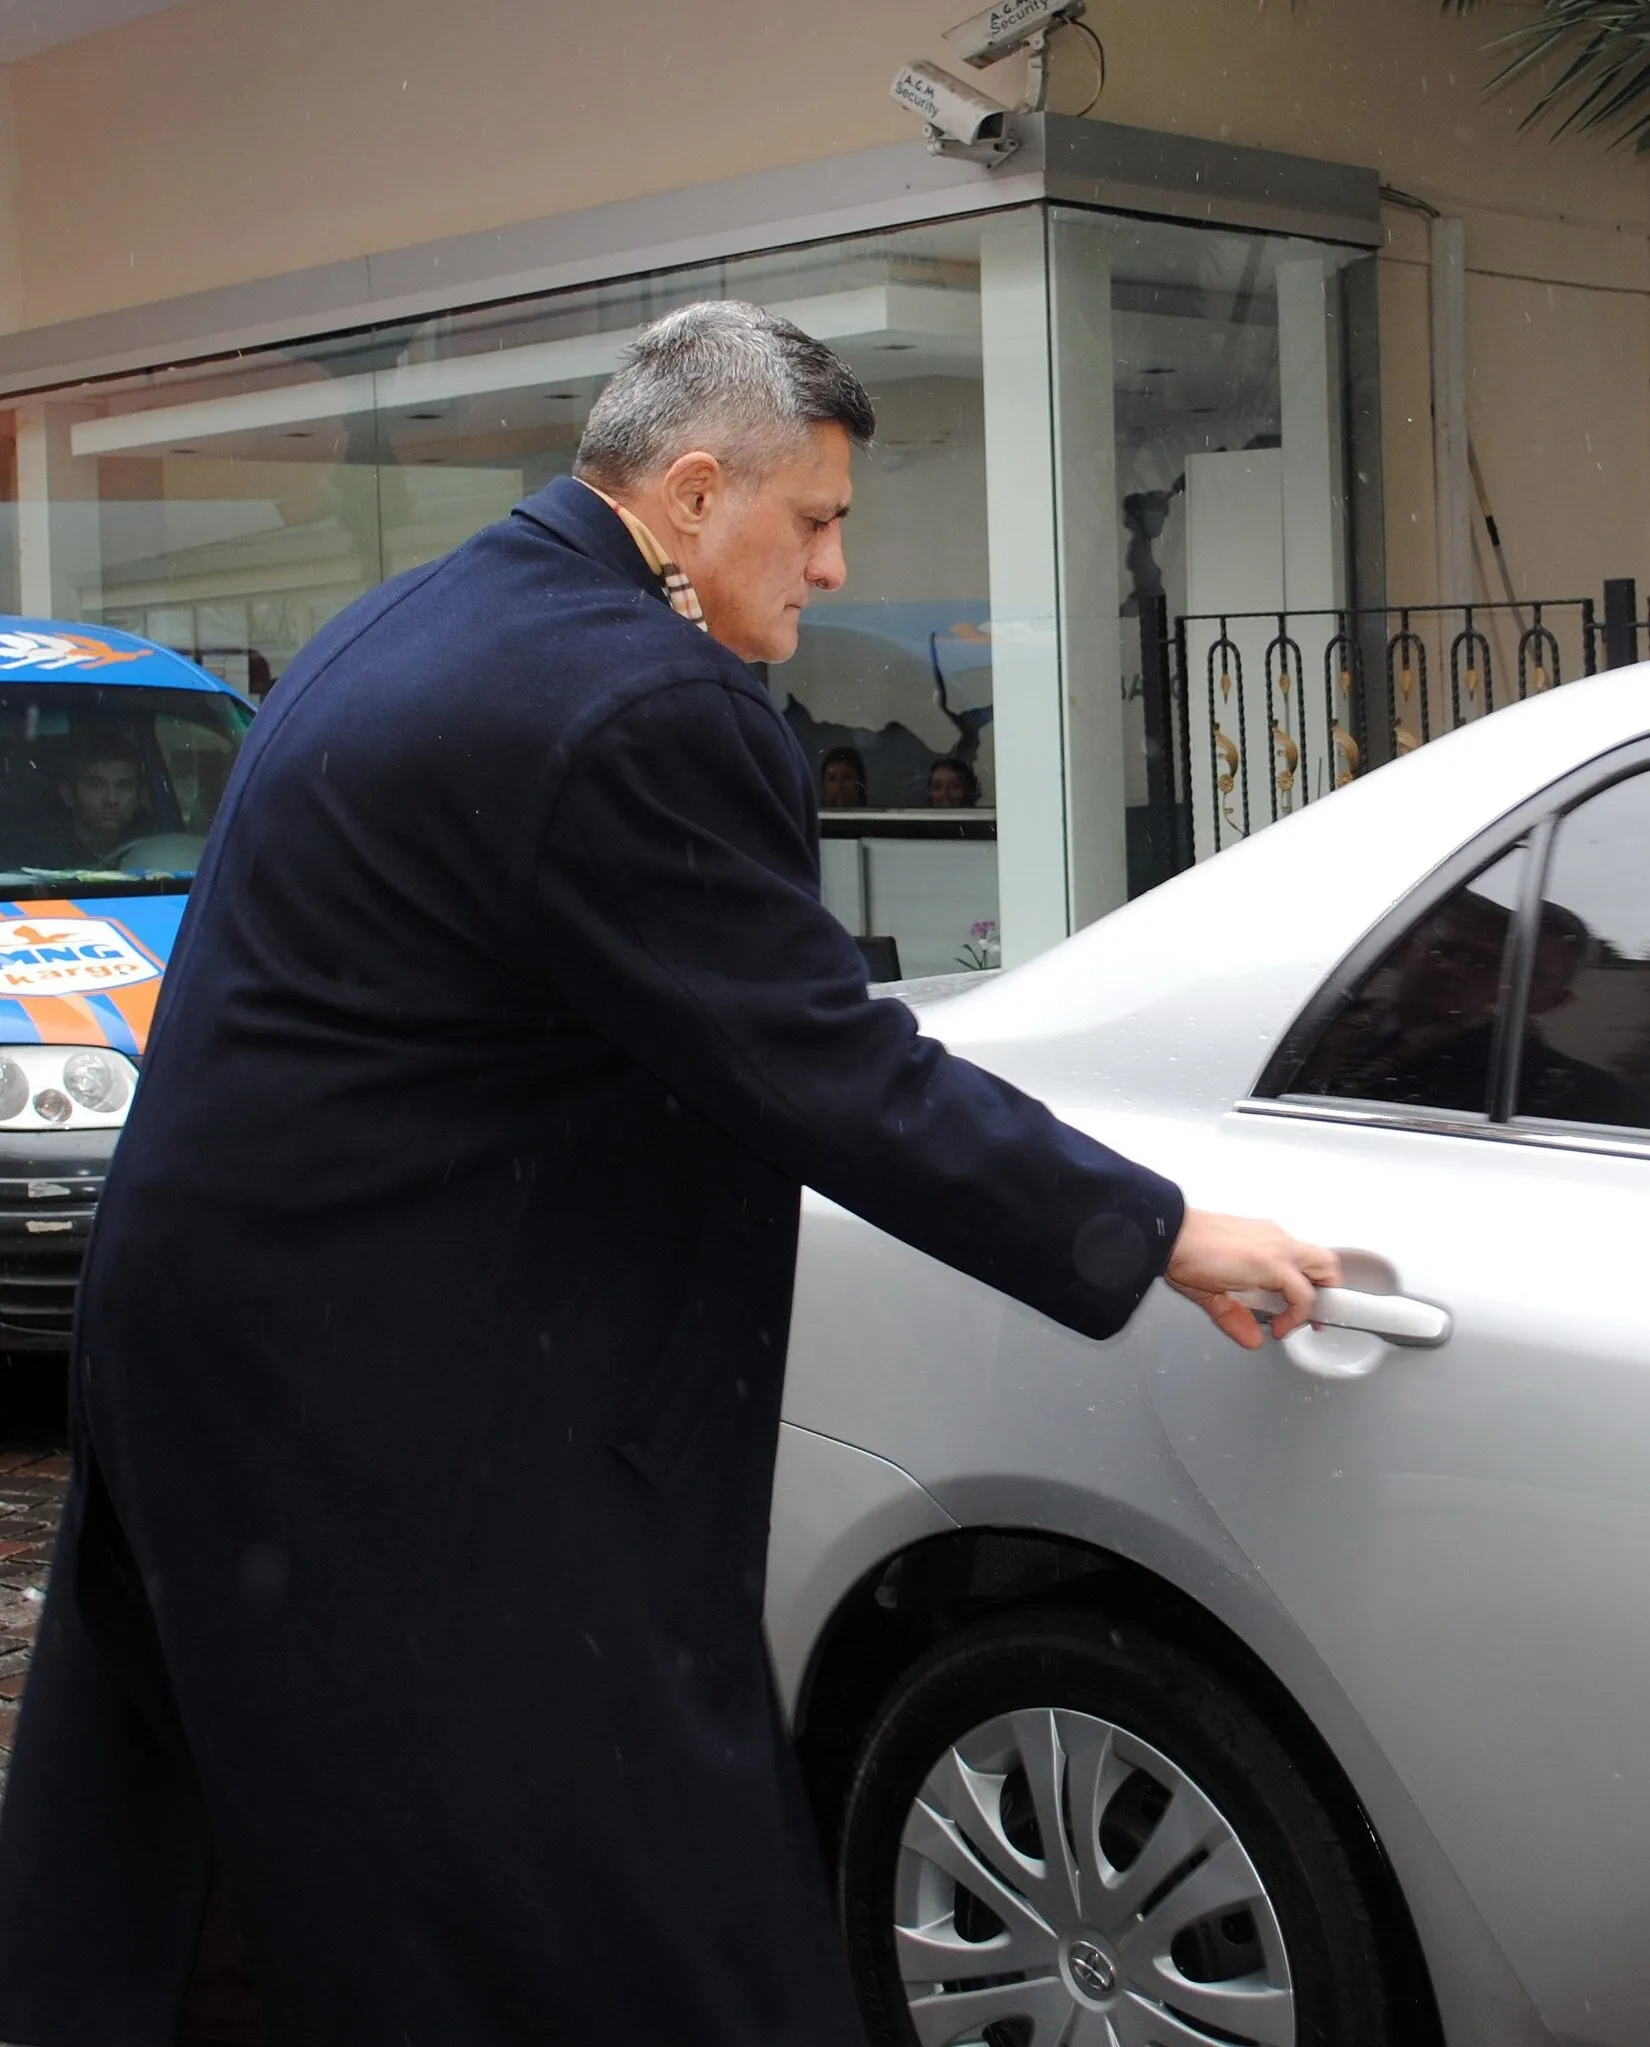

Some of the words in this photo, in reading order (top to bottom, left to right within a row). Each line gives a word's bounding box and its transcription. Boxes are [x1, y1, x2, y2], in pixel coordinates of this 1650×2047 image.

[991, 0, 1047, 35] Security
[895, 80, 939, 118] Security
[0, 944, 124, 969] MNG
